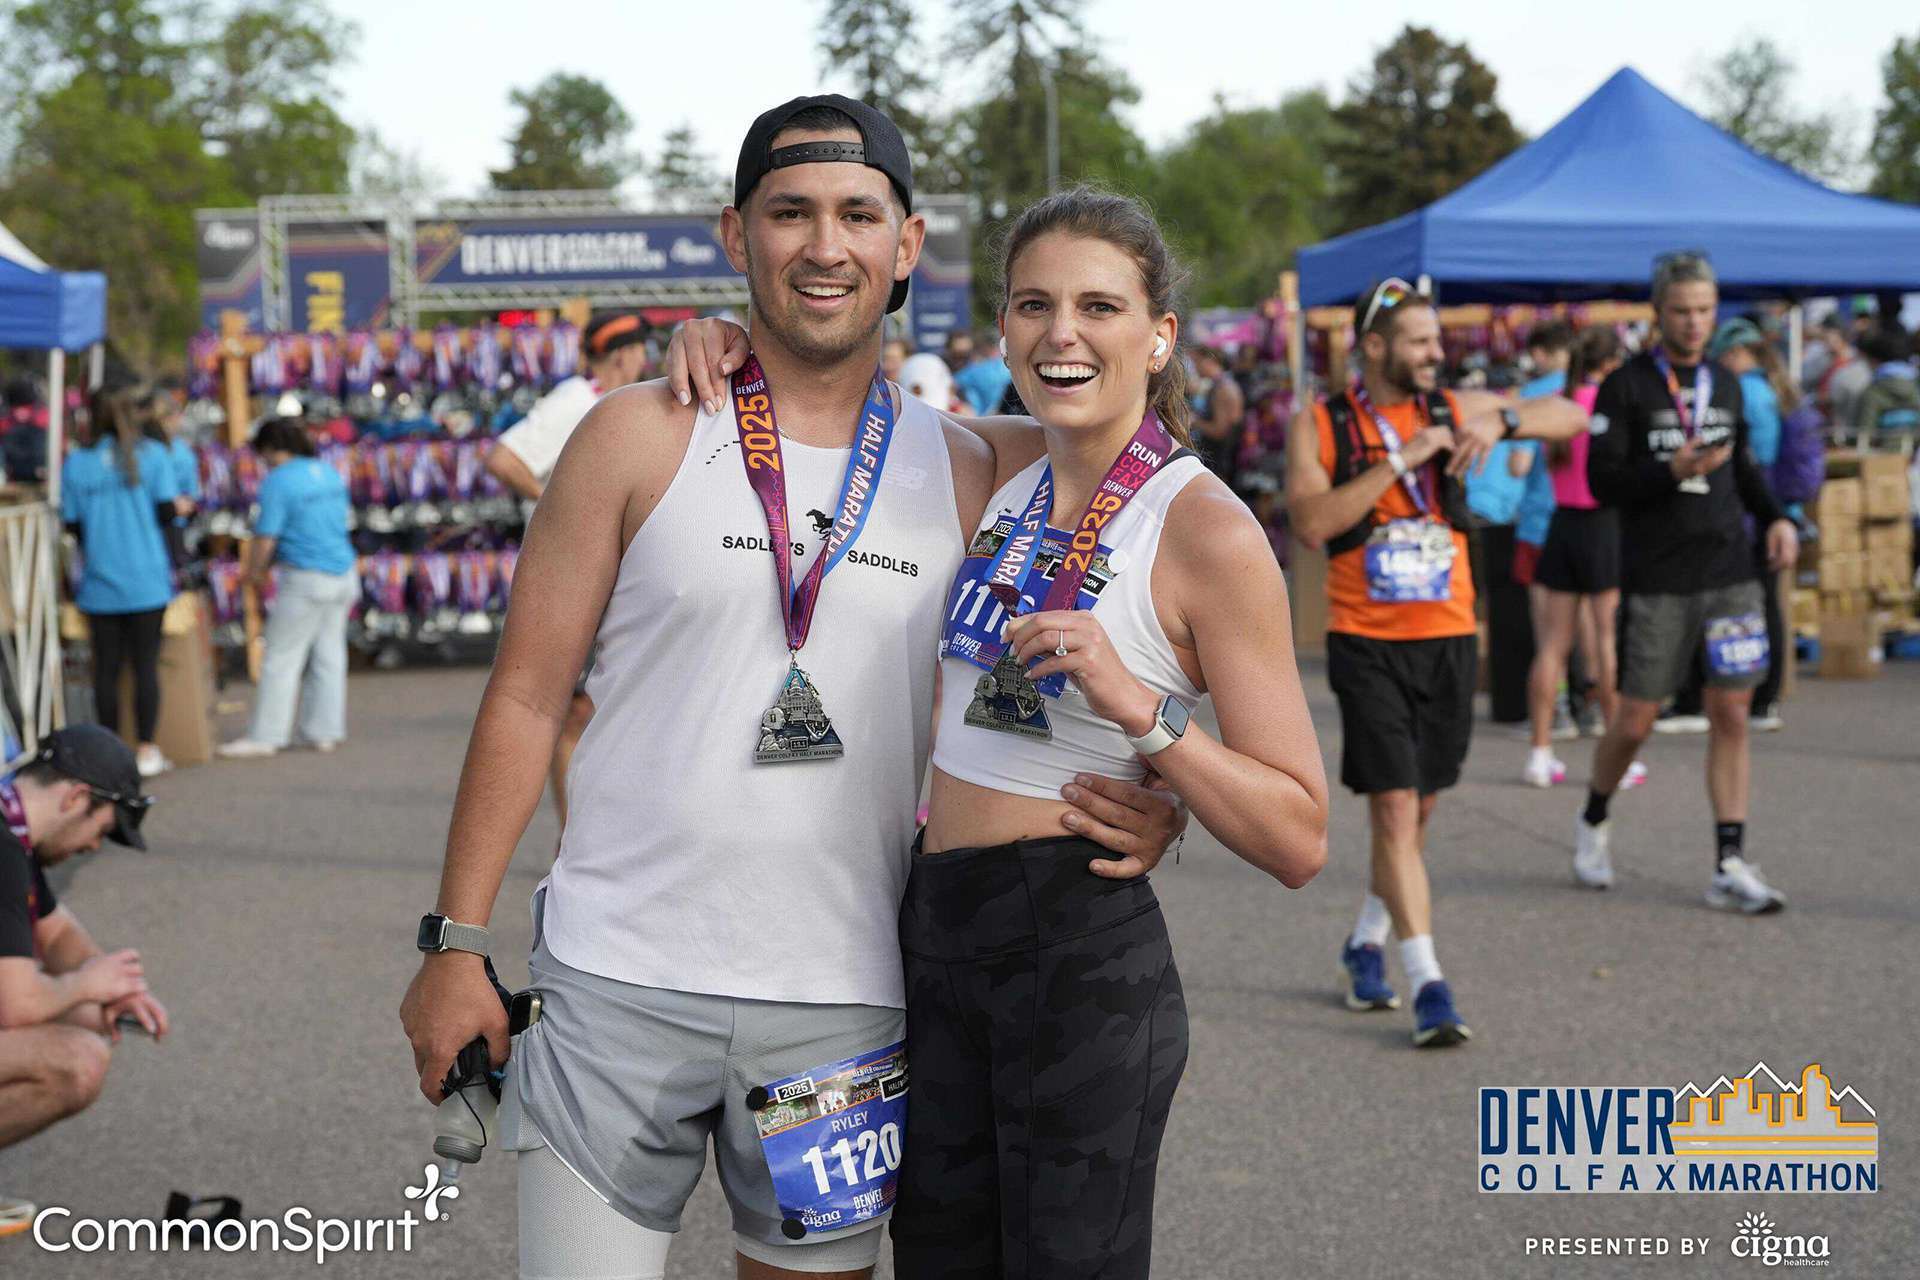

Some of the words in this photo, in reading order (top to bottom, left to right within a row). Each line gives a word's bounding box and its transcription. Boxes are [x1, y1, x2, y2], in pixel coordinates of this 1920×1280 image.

[461, 233, 564, 274] DENVER
[736, 379, 765, 395] DENVER
[737, 394, 780, 470] 2025
[859, 413, 887, 469] HALF
[1120, 455, 1150, 479] COL
[1128, 441, 1162, 468] RUN
[1103, 479, 1134, 498] DENVER
[1110, 467, 1143, 490] FAX
[825, 464, 874, 562] MARATH
[1022, 480, 1051, 531] HALF
[1064, 492, 1122, 572] 2025
[722, 535, 805, 556] SADLE'S
[847, 550, 919, 577] SADDLES
[992, 535, 1035, 586] MARA
[952, 632, 982, 654] DENVER
[965, 717, 985, 727] DENVER
[986, 720, 1006, 730] COLFAX
[1005, 724, 1019, 733] HALF
[1020, 727, 1048, 738] MARATHON
[781, 1084, 809, 1099] 2025
[831, 1111, 869, 1134] RYLEY
[802, 1122, 902, 1195] 1120
[801, 1210, 841, 1227] cigna
